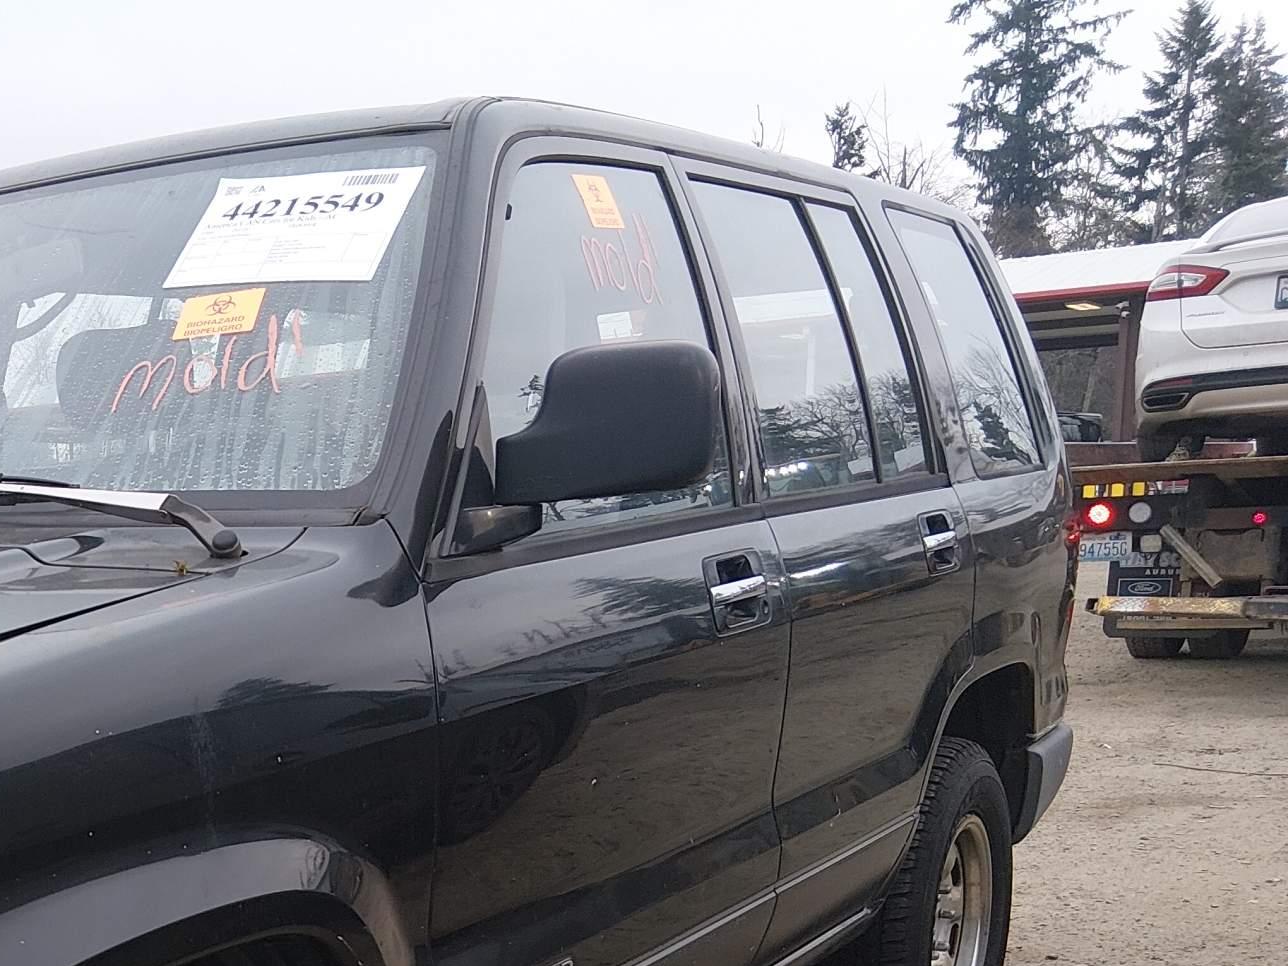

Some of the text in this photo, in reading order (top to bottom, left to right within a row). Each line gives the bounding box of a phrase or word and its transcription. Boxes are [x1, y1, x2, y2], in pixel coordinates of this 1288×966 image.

[221, 191, 384, 221] 44215549
[186, 315, 245, 328] BIOHAZARD
[183, 323, 243, 337] BIOPELIGRO
[1134, 584, 1155, 592] Ford
